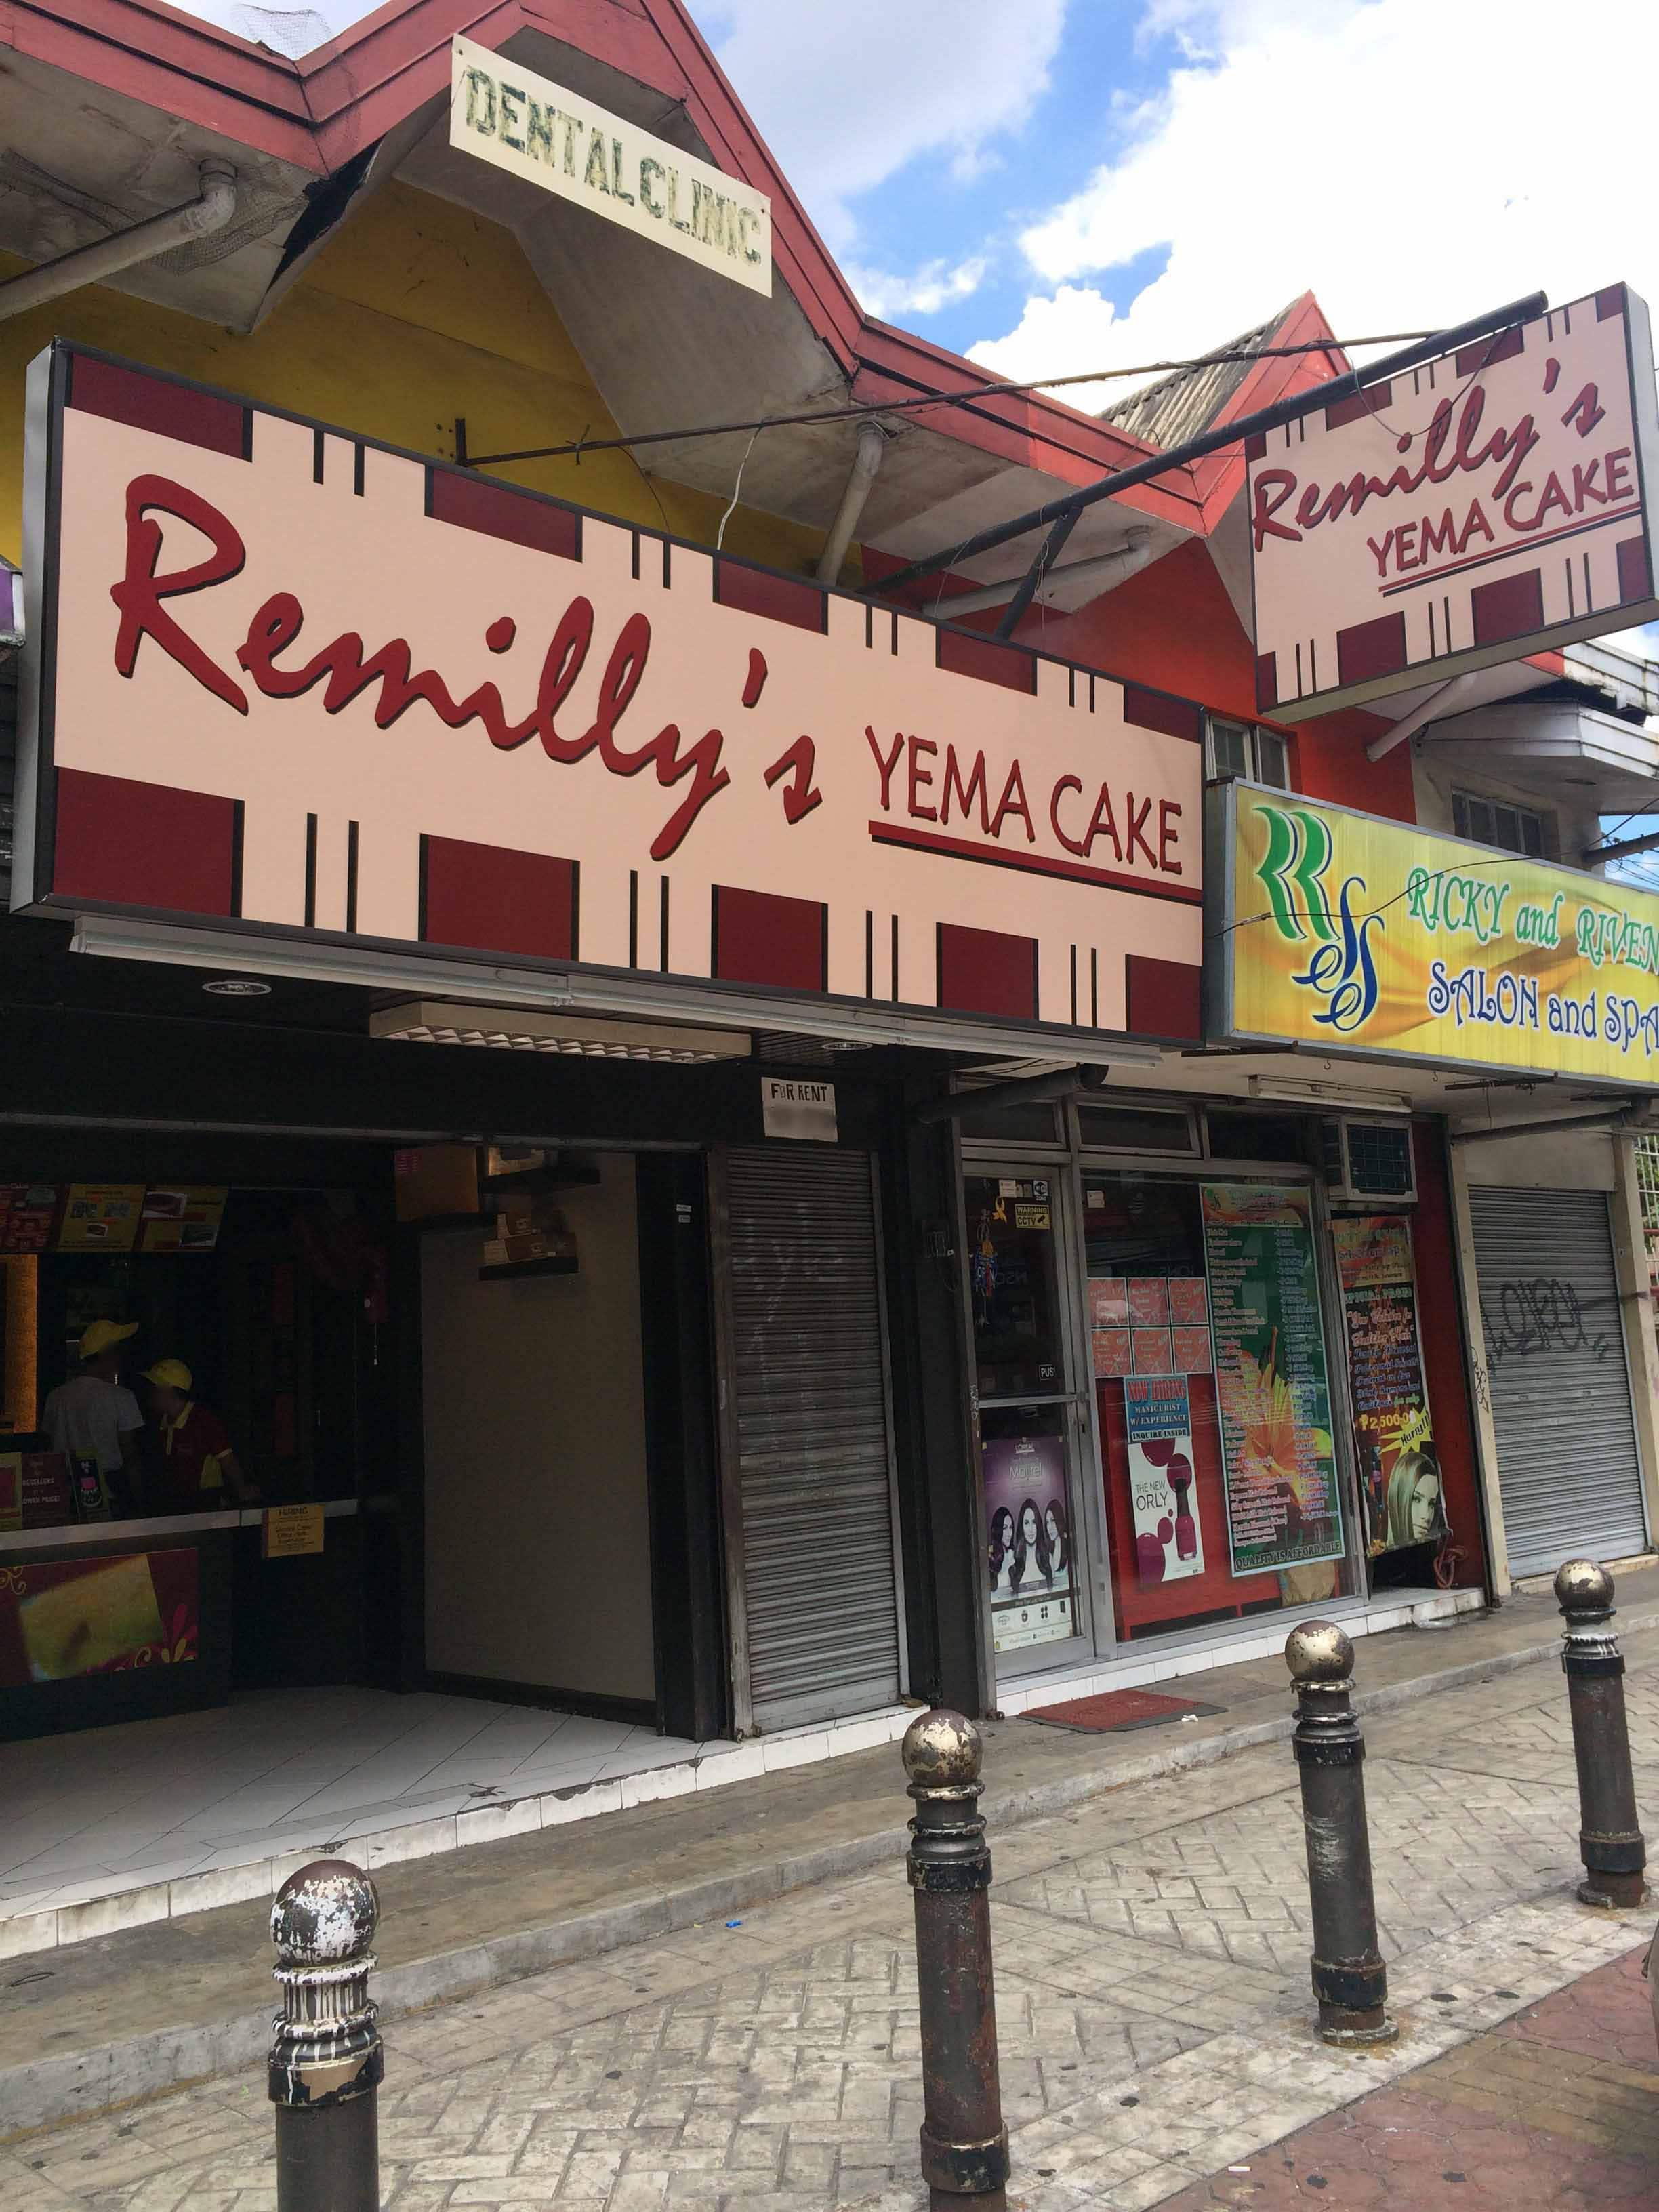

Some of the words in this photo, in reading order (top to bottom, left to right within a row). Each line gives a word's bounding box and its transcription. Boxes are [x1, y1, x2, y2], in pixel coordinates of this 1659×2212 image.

[466, 65, 634, 207] DENTAL
[640, 157, 762, 266] CLINIC
[1252, 357, 1606, 552] Remilly's
[1367, 498, 1494, 577] YEMA
[1504, 447, 1633, 531] CAKE
[110, 474, 821, 861] Remilly's
[865, 725, 1035, 843] YEMA
[1050, 774, 1183, 875] CAKE
[1408, 868, 1510, 946] RICKY
[1517, 895, 1563, 947] and
[1429, 962, 1538, 1028] SALON
[1549, 992, 1597, 1038] and
[1605, 996, 1659, 1055] SPA
[798, 1084, 827, 1101] RENT
[1017, 1206, 1048, 1215] WARNING
[1018, 1217, 1036, 1226] CCTV
[977, 1265, 999, 1290] OPN
[1128, 1380, 1148, 1401] NOW
[1134, 1404, 1180, 1414] MANICURIST
[1141, 1414, 1188, 1425] EXPERIENCE
[1132, 1431, 1161, 1439] INQUIRE
[1135, 1482, 1149, 1494] THE
[1150, 1480, 1166, 1490] NEW
[1136, 1491, 1168, 1511] ORLY
[1235, 1551, 1274, 1570] QUALITY
[1275, 1550, 1286, 1561] IS
[1286, 1540, 1341, 1560] AFFORDABLE
